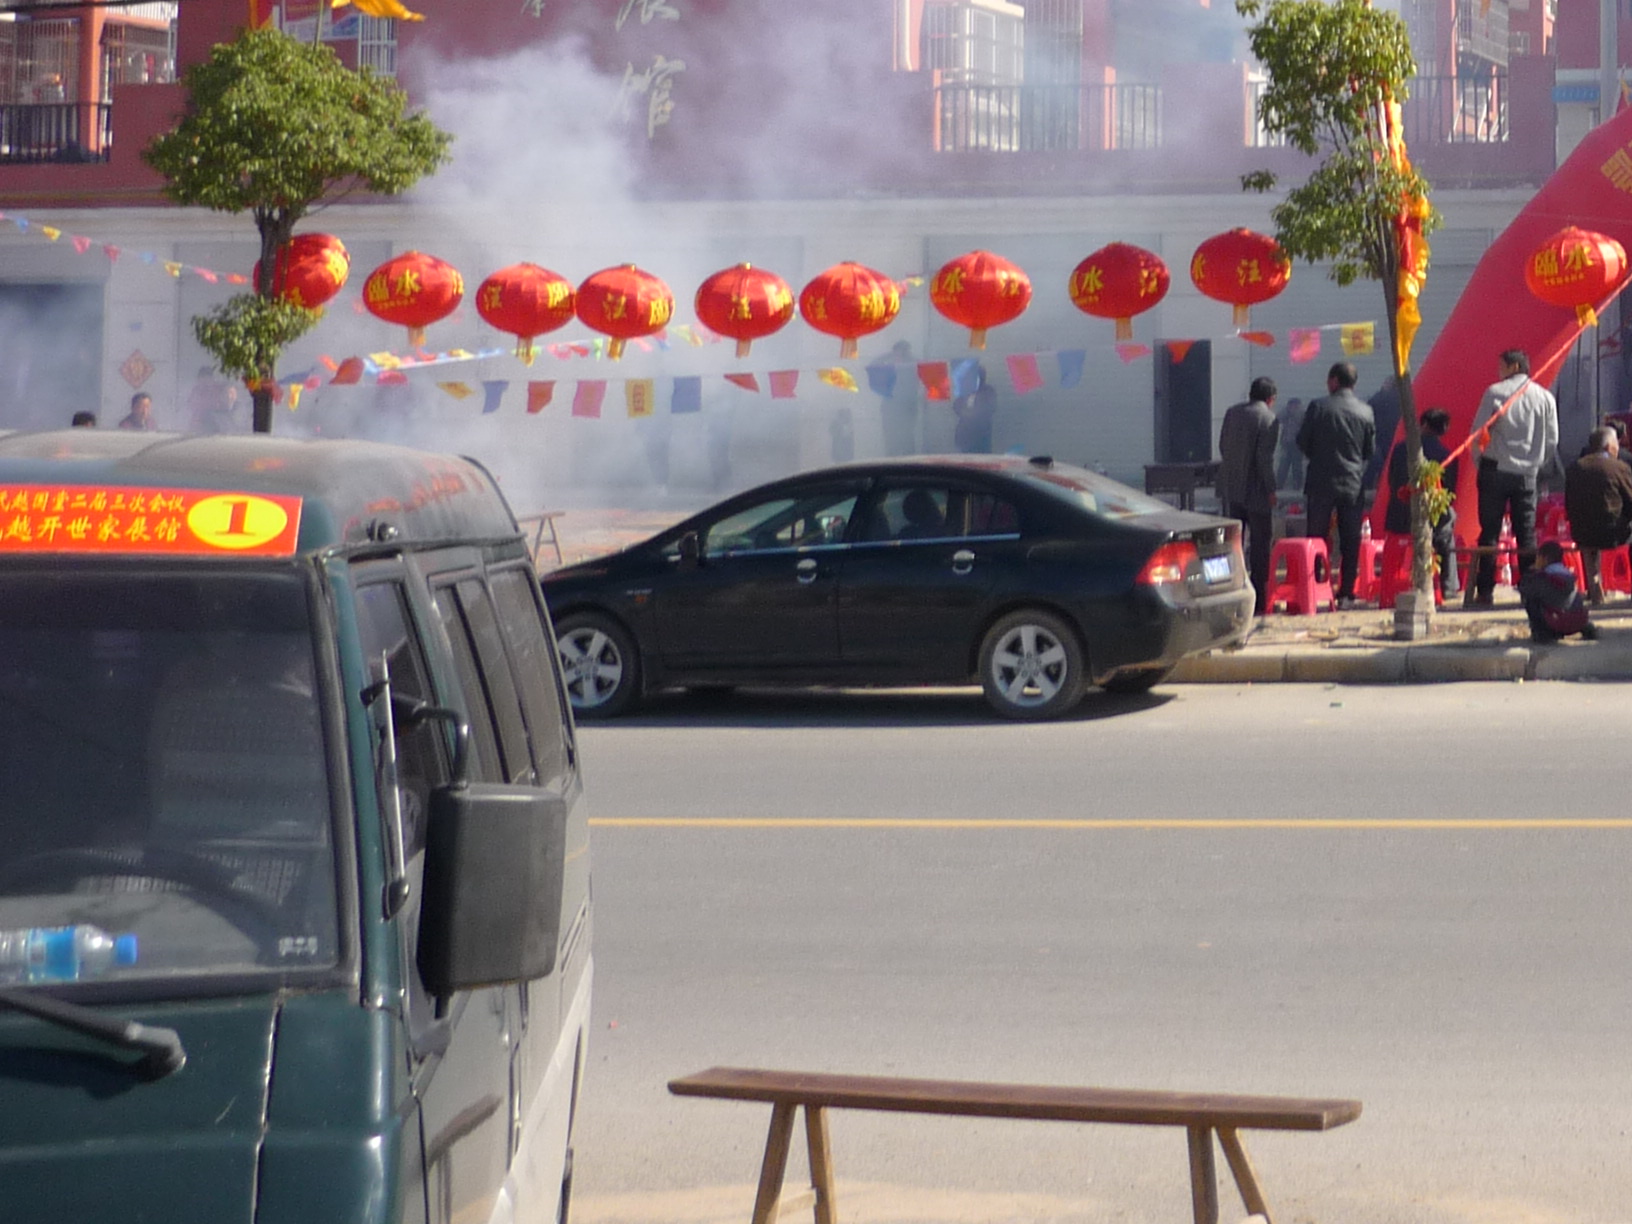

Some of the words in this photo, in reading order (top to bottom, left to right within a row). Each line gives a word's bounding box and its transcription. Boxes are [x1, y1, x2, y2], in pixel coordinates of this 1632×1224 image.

[0, 514, 182, 543] 越开世家展馆
[215, 500, 256, 536] 1
